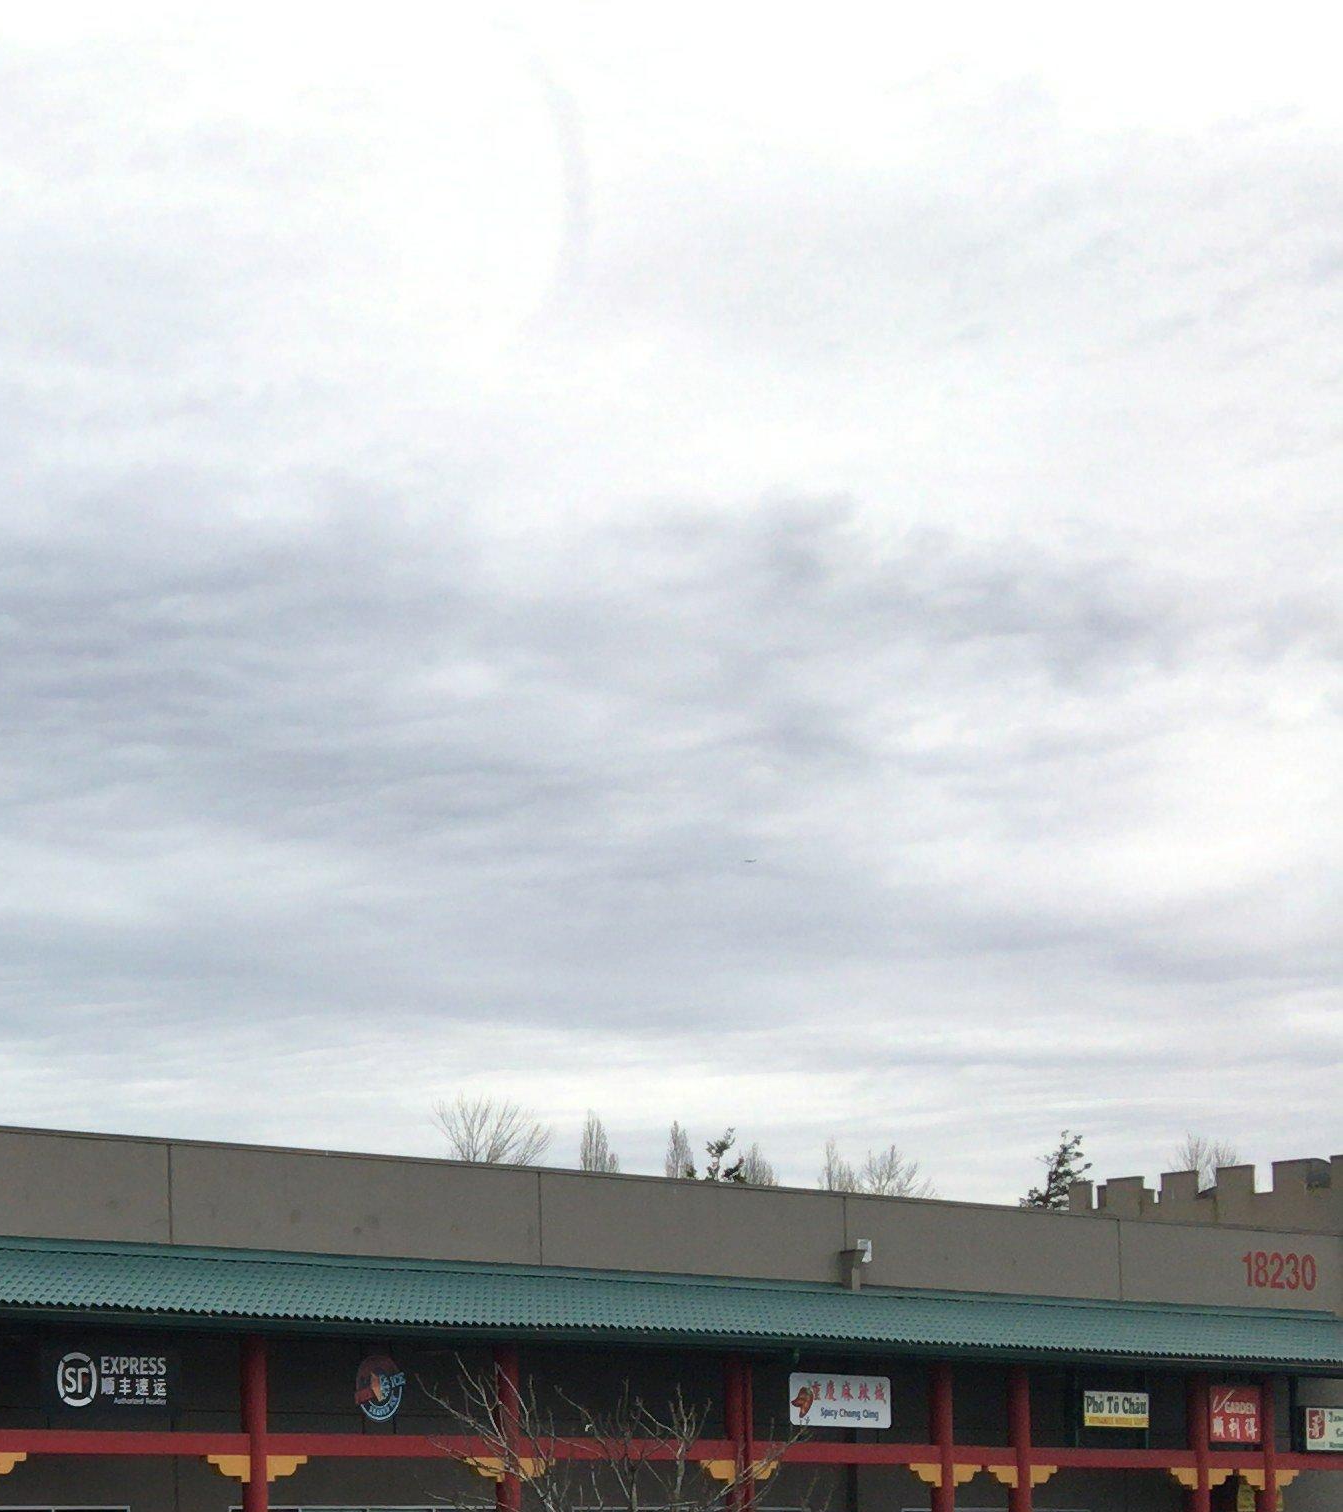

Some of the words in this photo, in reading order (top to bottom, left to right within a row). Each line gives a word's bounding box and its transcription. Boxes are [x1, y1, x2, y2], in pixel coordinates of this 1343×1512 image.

[1241, 1251, 1317, 1291] 18230
[100, 1356, 167, 1376] EXPRESS
[820, 1406, 838, 1419] Spicy
[1224, 1401, 1256, 1415] GARDEN
